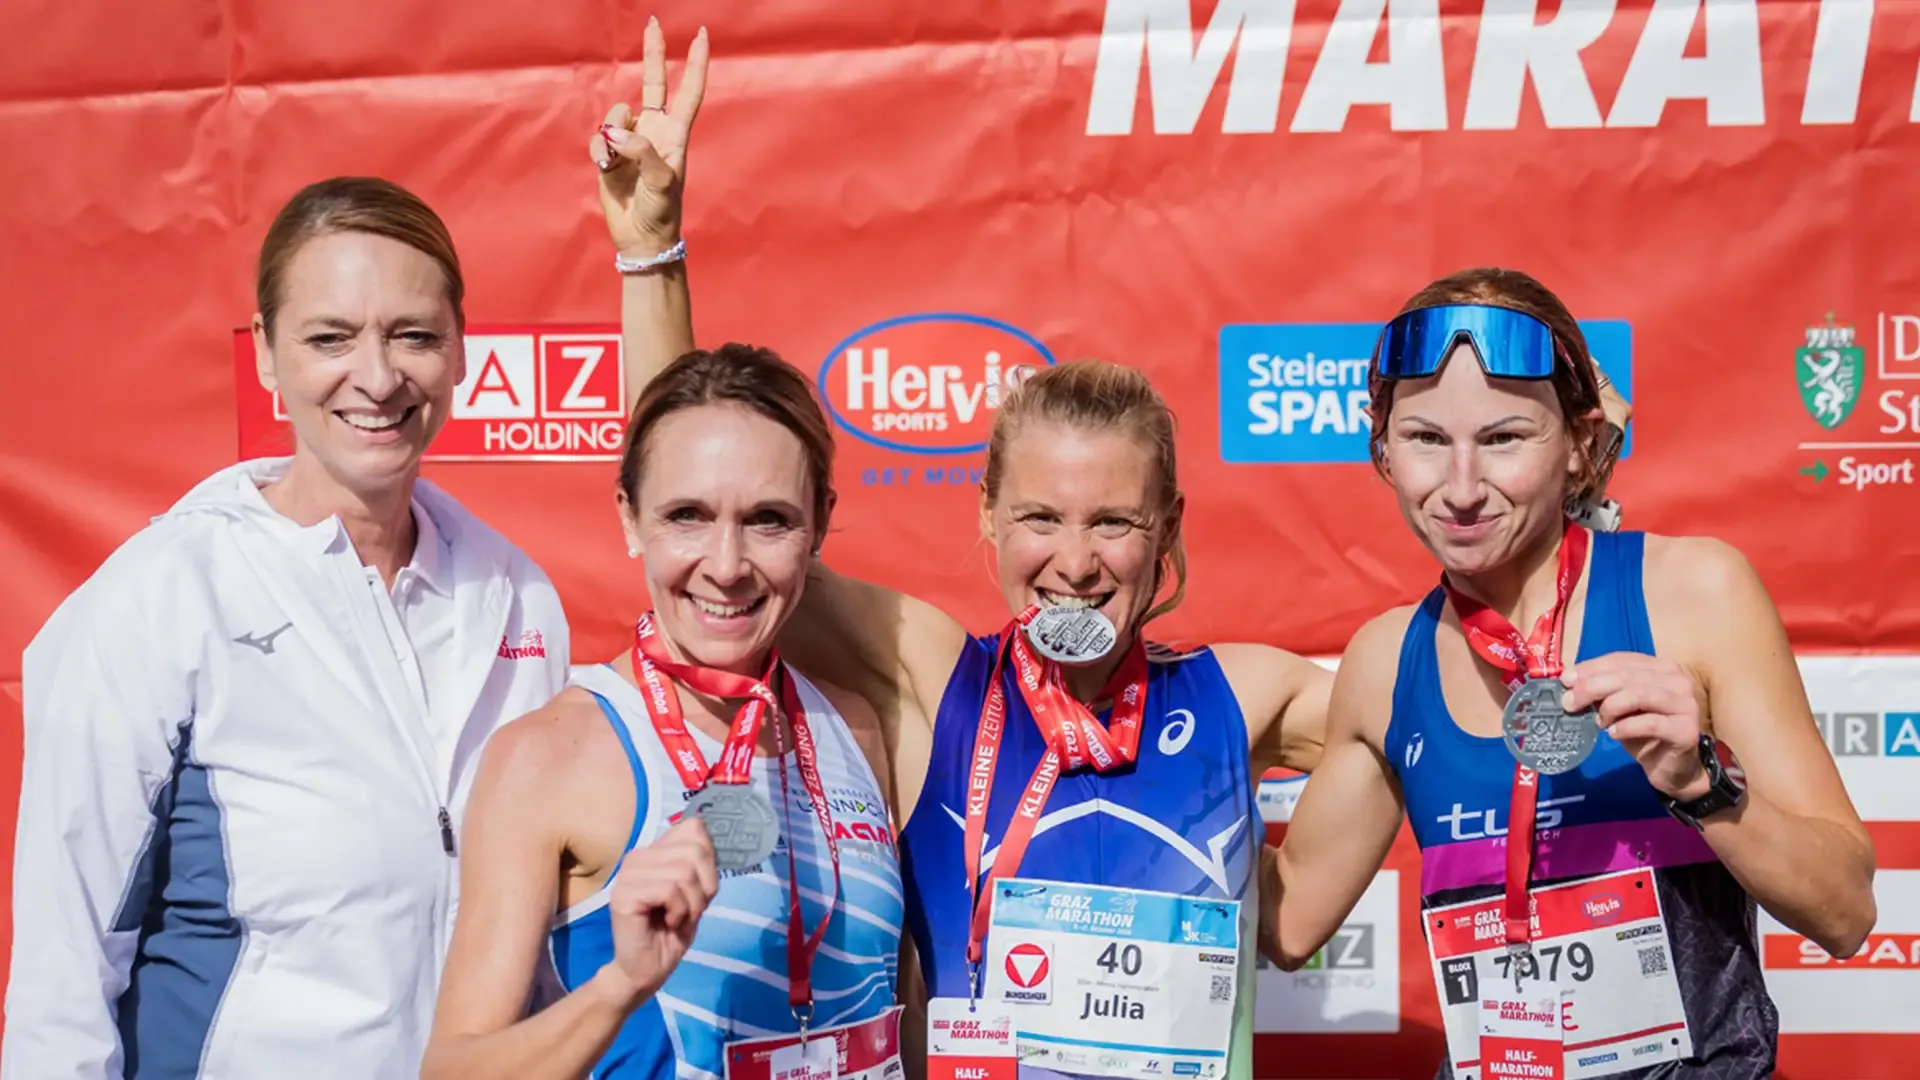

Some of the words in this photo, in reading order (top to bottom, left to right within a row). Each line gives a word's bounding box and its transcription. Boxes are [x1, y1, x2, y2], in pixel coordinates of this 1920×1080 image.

[1085, 0, 1920, 135] MARAT
[871, 412, 949, 432] SPORTS
[484, 422, 623, 451] HOLDING
[861, 467, 913, 486] GET
[924, 467, 984, 486] MOV
[1838, 456, 1914, 491] Sport
[795, 724, 821, 790] ZEITUNG
[969, 744, 995, 816] KLEINE
[1051, 894, 1093, 910] GRAZ
[1045, 906, 1135, 928] MARATHON
[1474, 908, 1502, 927] GRAZ
[1096, 942, 1142, 976] 40
[1448, 962, 1472, 974] BLOCK
[1457, 974, 1470, 999] 1
[1080, 992, 1145, 1020] Julia
[1502, 1001, 1528, 1011] GRAZ
[952, 1020, 981, 1030] GRAZ
[1499, 1010, 1554, 1022] MARATHON
[950, 1030, 1009, 1040] MARATHON
[1505, 1049, 1538, 1062] HALF-
[954, 1067, 989, 1080] HALF-
[1489, 1062, 1554, 1077] MARATHON
